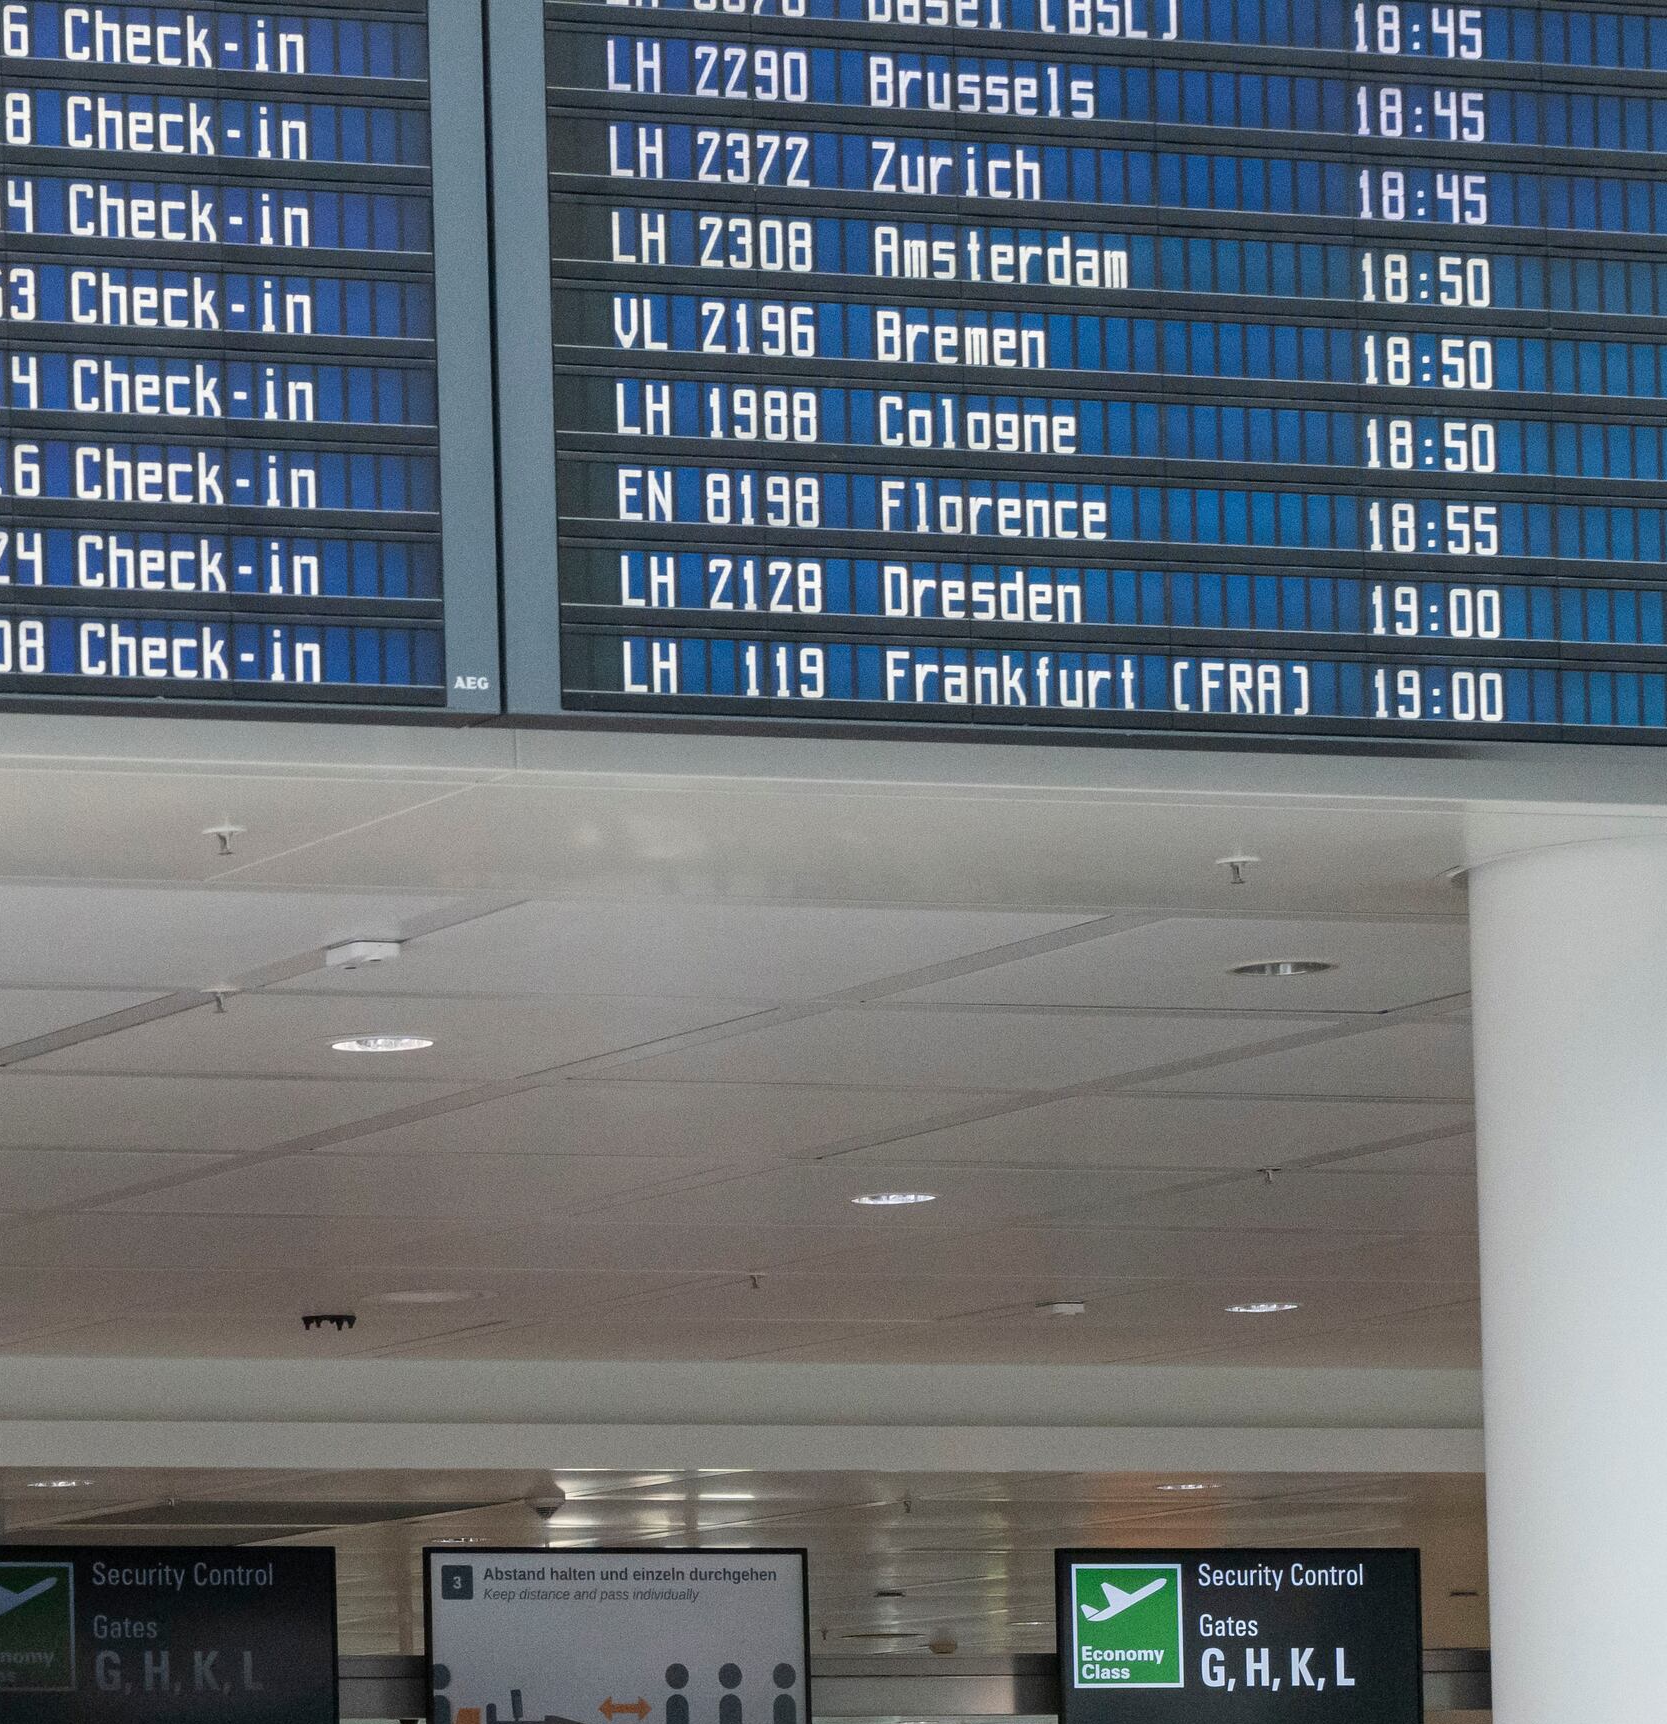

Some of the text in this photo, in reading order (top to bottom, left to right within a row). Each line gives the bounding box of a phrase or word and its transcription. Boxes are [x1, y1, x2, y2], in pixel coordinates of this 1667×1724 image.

[607, 40, 1485, 143] LH 2290 Brussels 18:45
[67, 95, 307, 161] Check-in
[611, 211, 1490, 308] LH 2308 Amsterdam 18:50
[73, 358, 313, 422] Check-in
[77, 533, 317, 597] Check-in
[620, 554, 1500, 639] LH 2128 Dresden 19:00
[454, 676, 489, 690] AEG
[622, 640, 677, 693] LH
[747, 646, 823, 699] 119
[886, 650, 1135, 710] Frankfurt
[1375, 667, 1503, 722] 19:00
[92, 1562, 273, 1591] Security Control
[453, 1567, 777, 1589] 3 Abstand halten und einzeln durchgehen
[1198, 1562, 1363, 1591] Security Control
[483, 1588, 699, 1603] Keep distance and pass individually
[93, 1615, 158, 1639] Gates
[1199, 1614, 1258, 1637] Gates
[1081, 1646, 1165, 1664] Economy
[1201, 1647, 1355, 1691] G, H, K, L
[1081, 1664, 1131, 1680] Class
